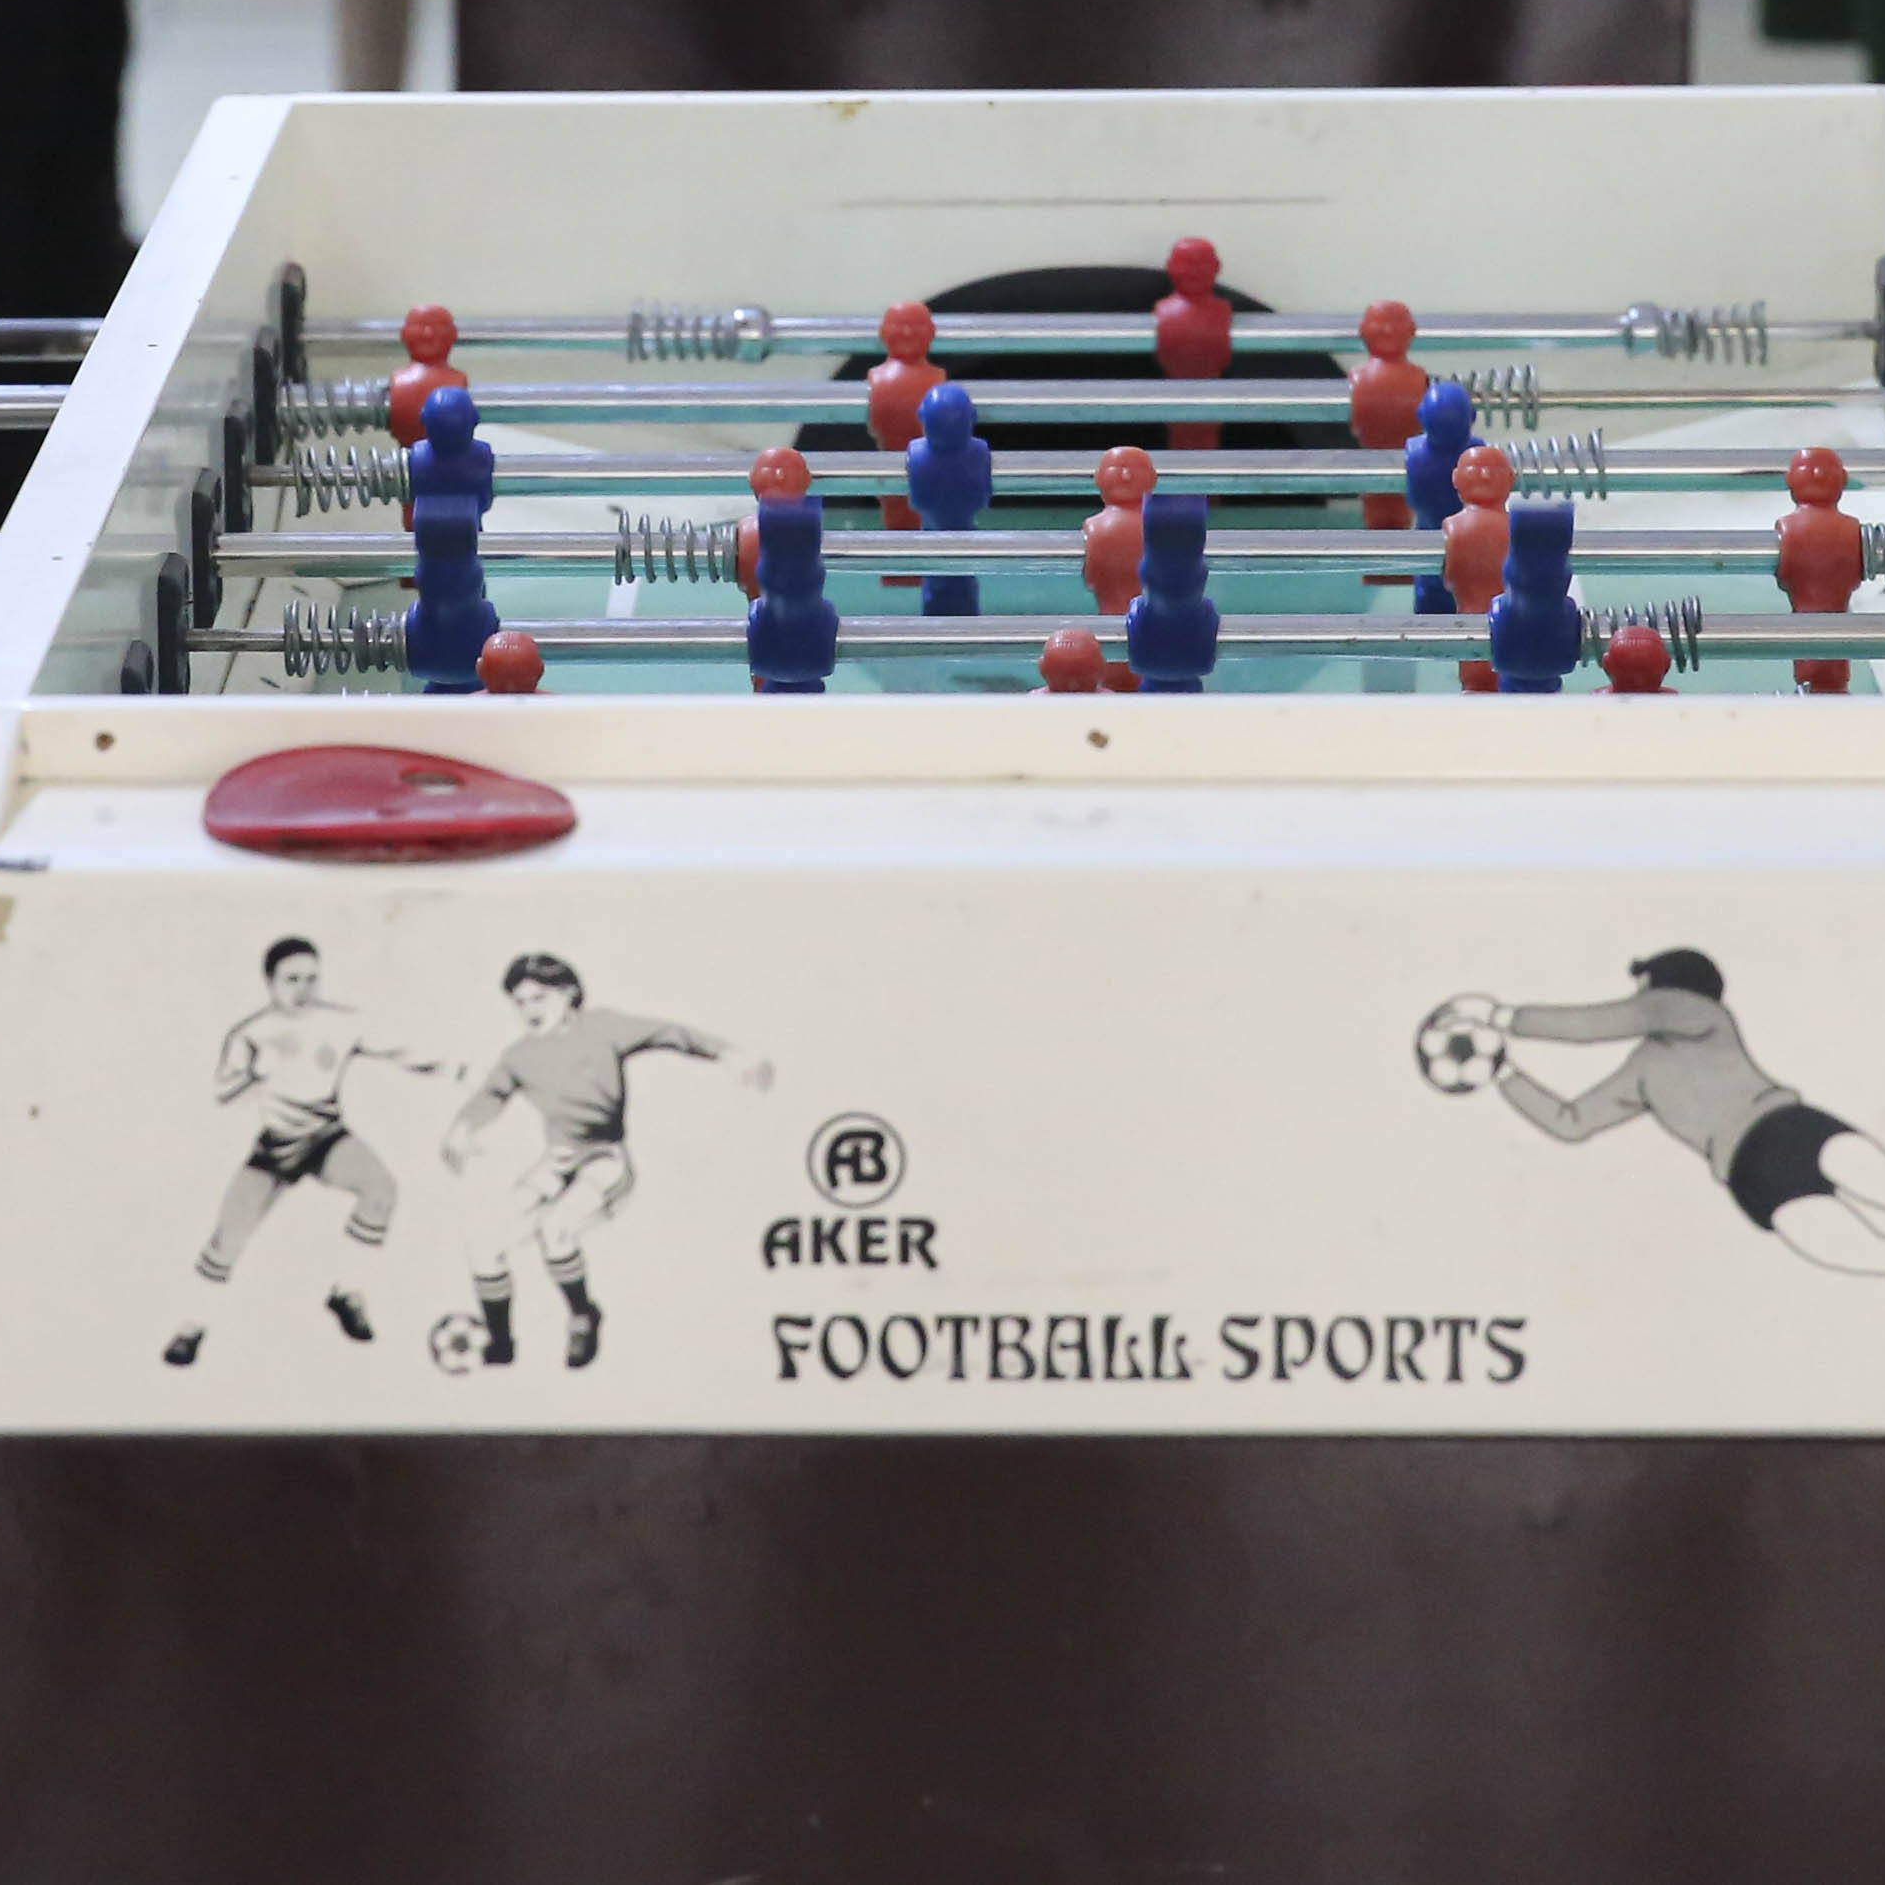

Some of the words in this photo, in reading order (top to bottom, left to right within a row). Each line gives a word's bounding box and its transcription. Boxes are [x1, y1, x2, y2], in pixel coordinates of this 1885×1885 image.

[761, 1217, 940, 1269] AKER
[773, 1314, 1193, 1381] FOOTBALL
[1220, 1314, 1527, 1383] SPORTS
